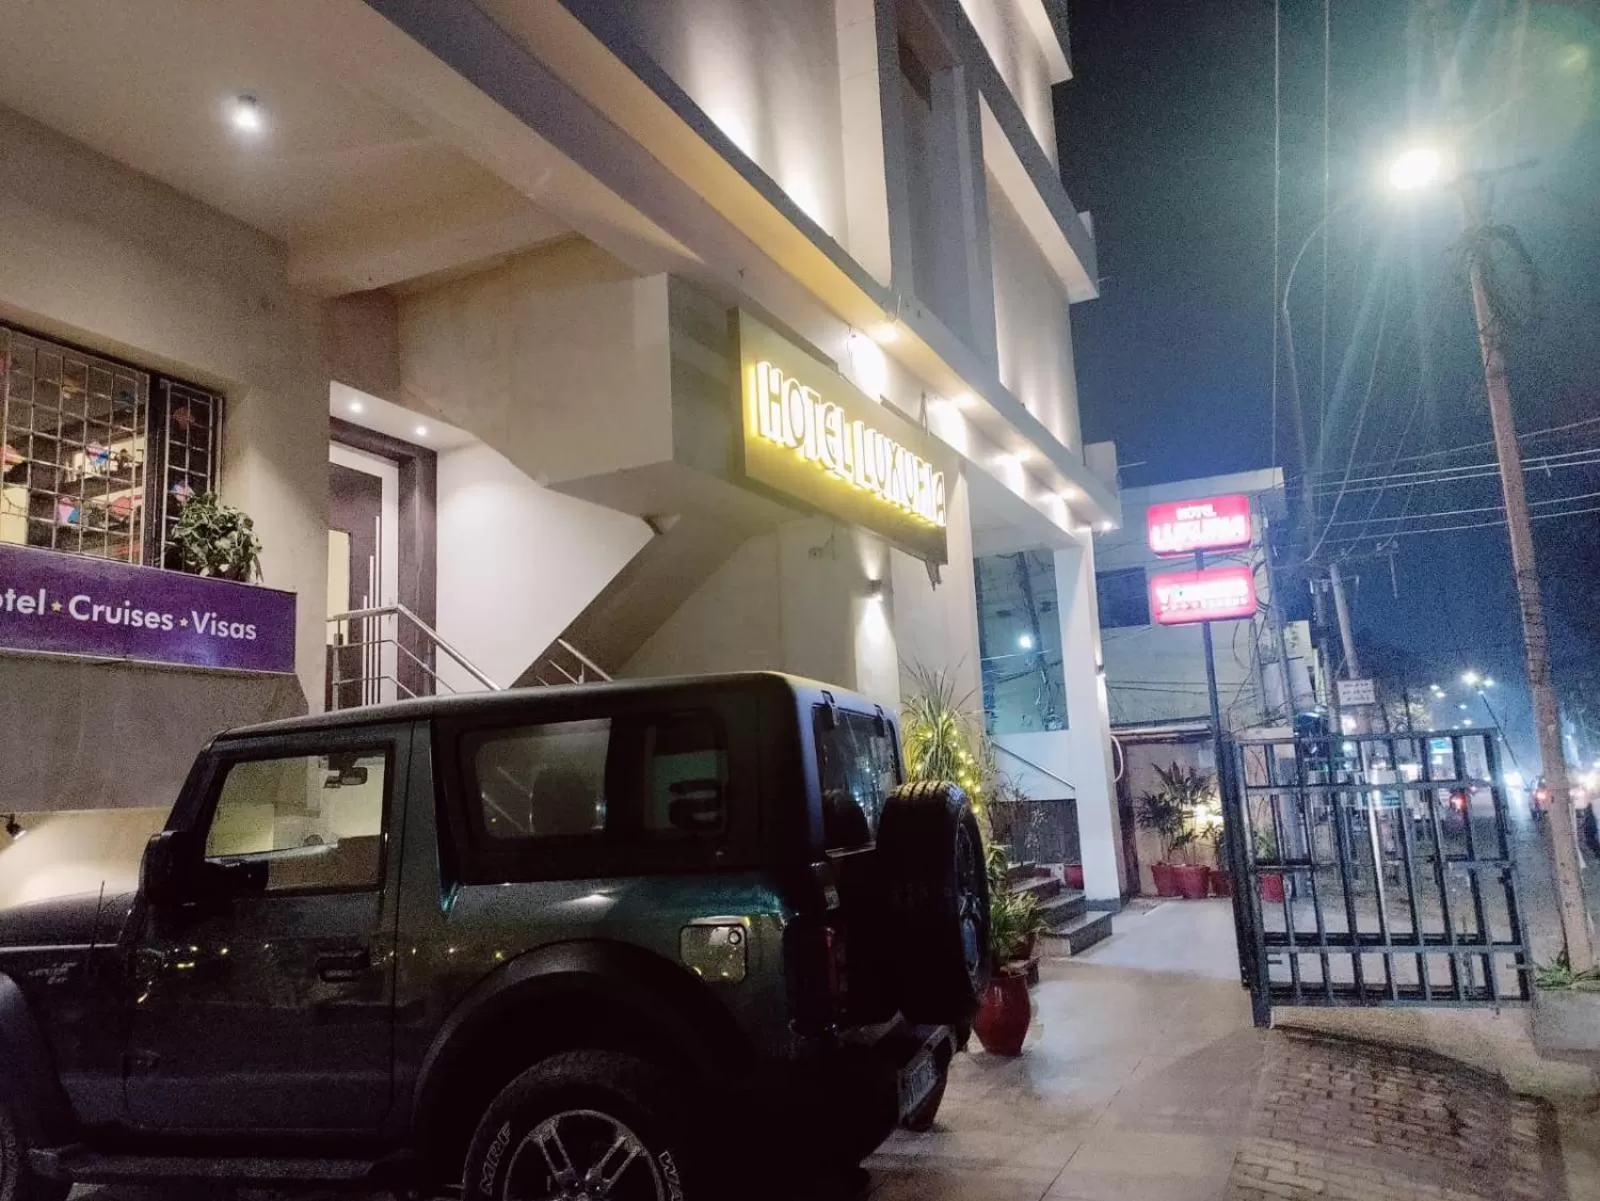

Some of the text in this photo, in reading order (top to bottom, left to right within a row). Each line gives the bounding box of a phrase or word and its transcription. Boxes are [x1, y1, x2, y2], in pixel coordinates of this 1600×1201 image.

[0, 588, 258, 640] tel Cruises Visas
